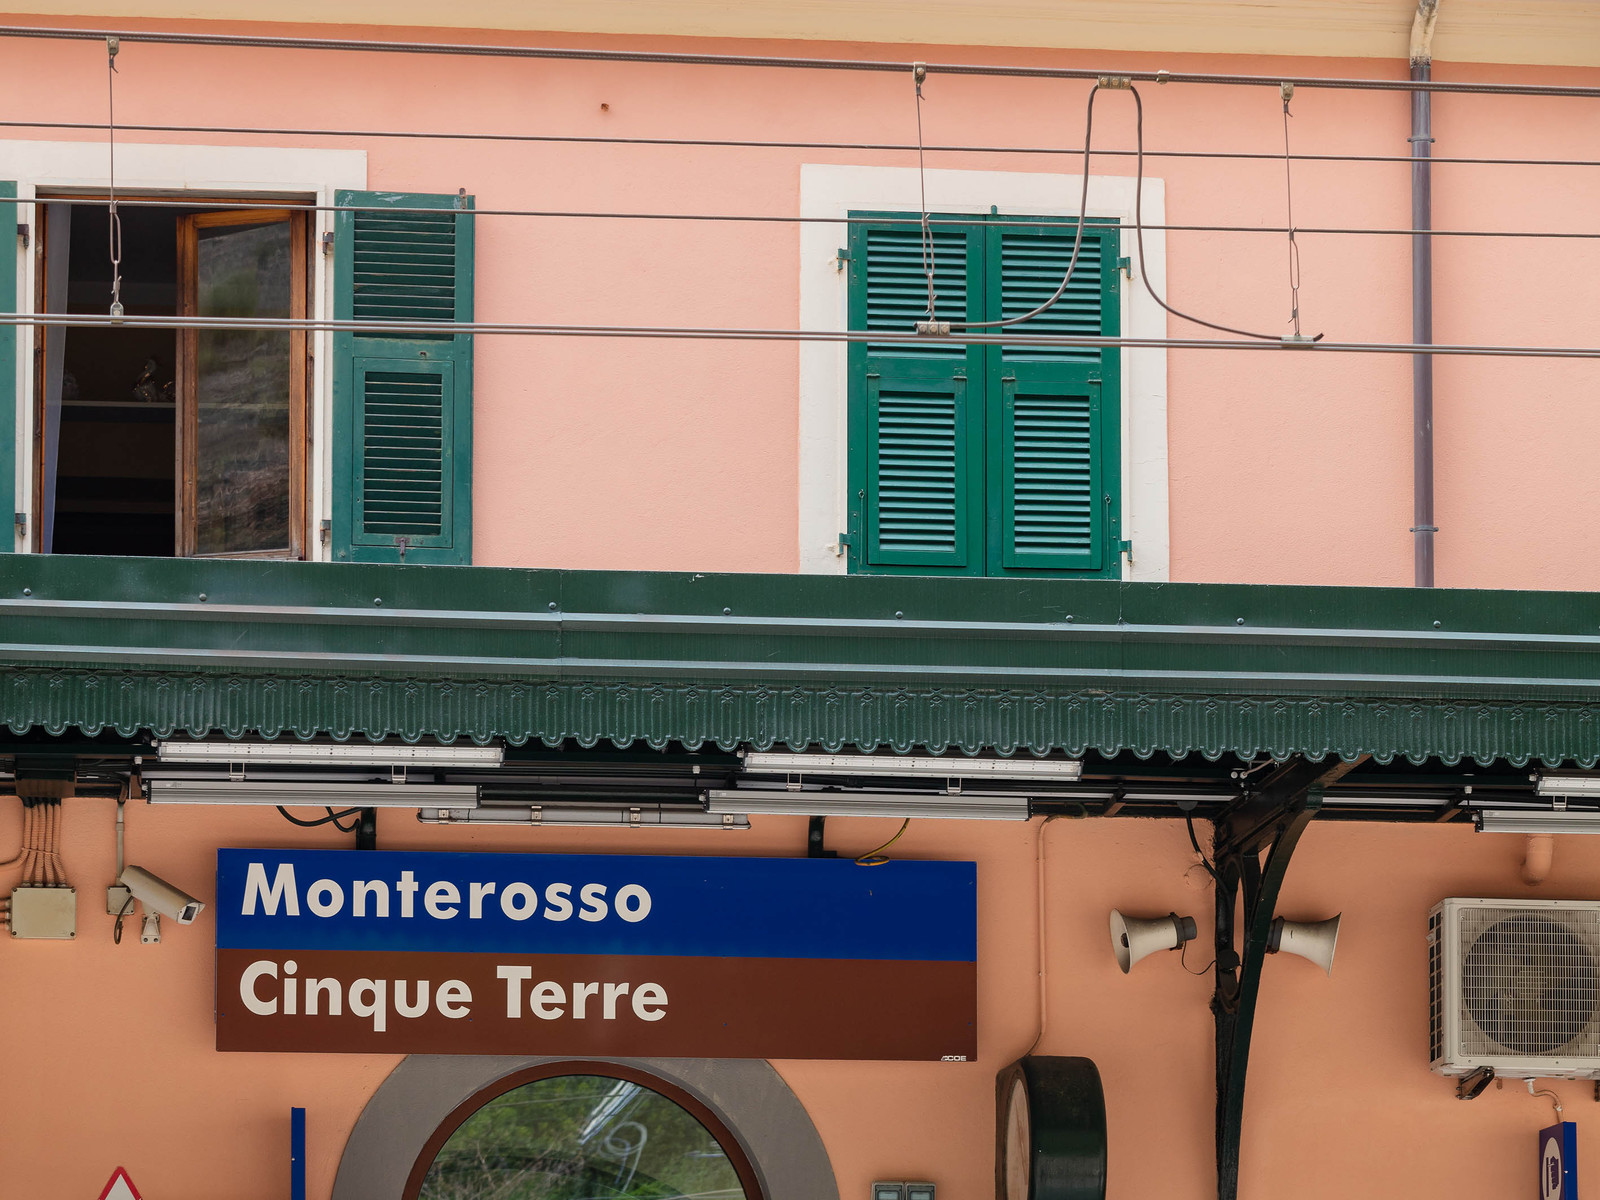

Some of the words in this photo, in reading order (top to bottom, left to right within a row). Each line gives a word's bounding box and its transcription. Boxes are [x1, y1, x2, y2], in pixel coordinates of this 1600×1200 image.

[241, 862, 652, 922] Monterosso
[239, 960, 473, 1032] Cinque
[496, 965, 669, 1022] Terre
